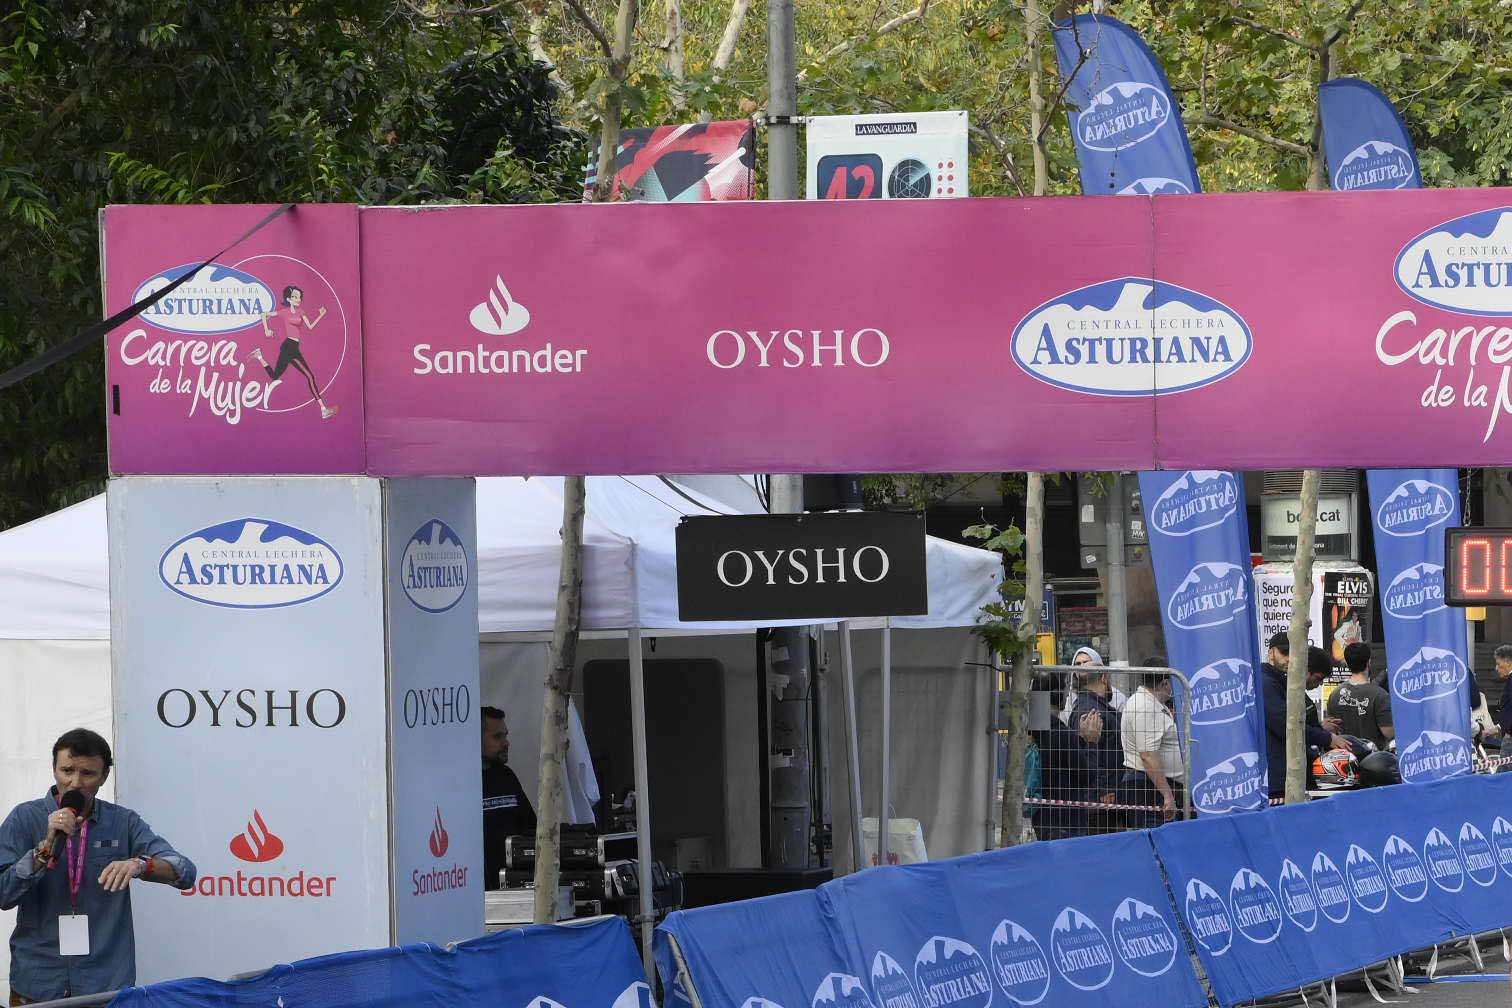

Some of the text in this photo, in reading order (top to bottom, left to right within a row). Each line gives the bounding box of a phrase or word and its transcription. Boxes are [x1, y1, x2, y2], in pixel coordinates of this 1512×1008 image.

[868, 122, 917, 135] VANGUARDIA
[144, 289, 263, 317] ASTURIANA
[169, 287, 208, 295] ENTRAL
[1066, 317, 1226, 332] CENTRAL LECHERA
[121, 328, 239, 368] Carrera
[413, 341, 588, 375] Santander
[706, 328, 890, 369] OYSHO
[1030, 321, 1235, 366] ASTURIANA
[150, 362, 283, 425] de la Mujer
[1421, 371, 1457, 409] de
[1463, 369, 1488, 408] la
[174, 552, 331, 586] ASTURIANA
[201, 549, 324, 560] CENTRAL LECHERA
[716, 545, 890, 587] OYSHO
[406, 555, 465, 590] ASTURIANA
[1337, 580, 1368, 594] ELVIS
[1262, 598, 1279, 610] que
[157, 688, 347, 728] OYSHO
[403, 684, 471, 729] OYSHO
[412, 863, 468, 897] Santander
[995, 954, 1048, 987] ASTURIANA
[1057, 941, 1112, 973] ASTURIANA
